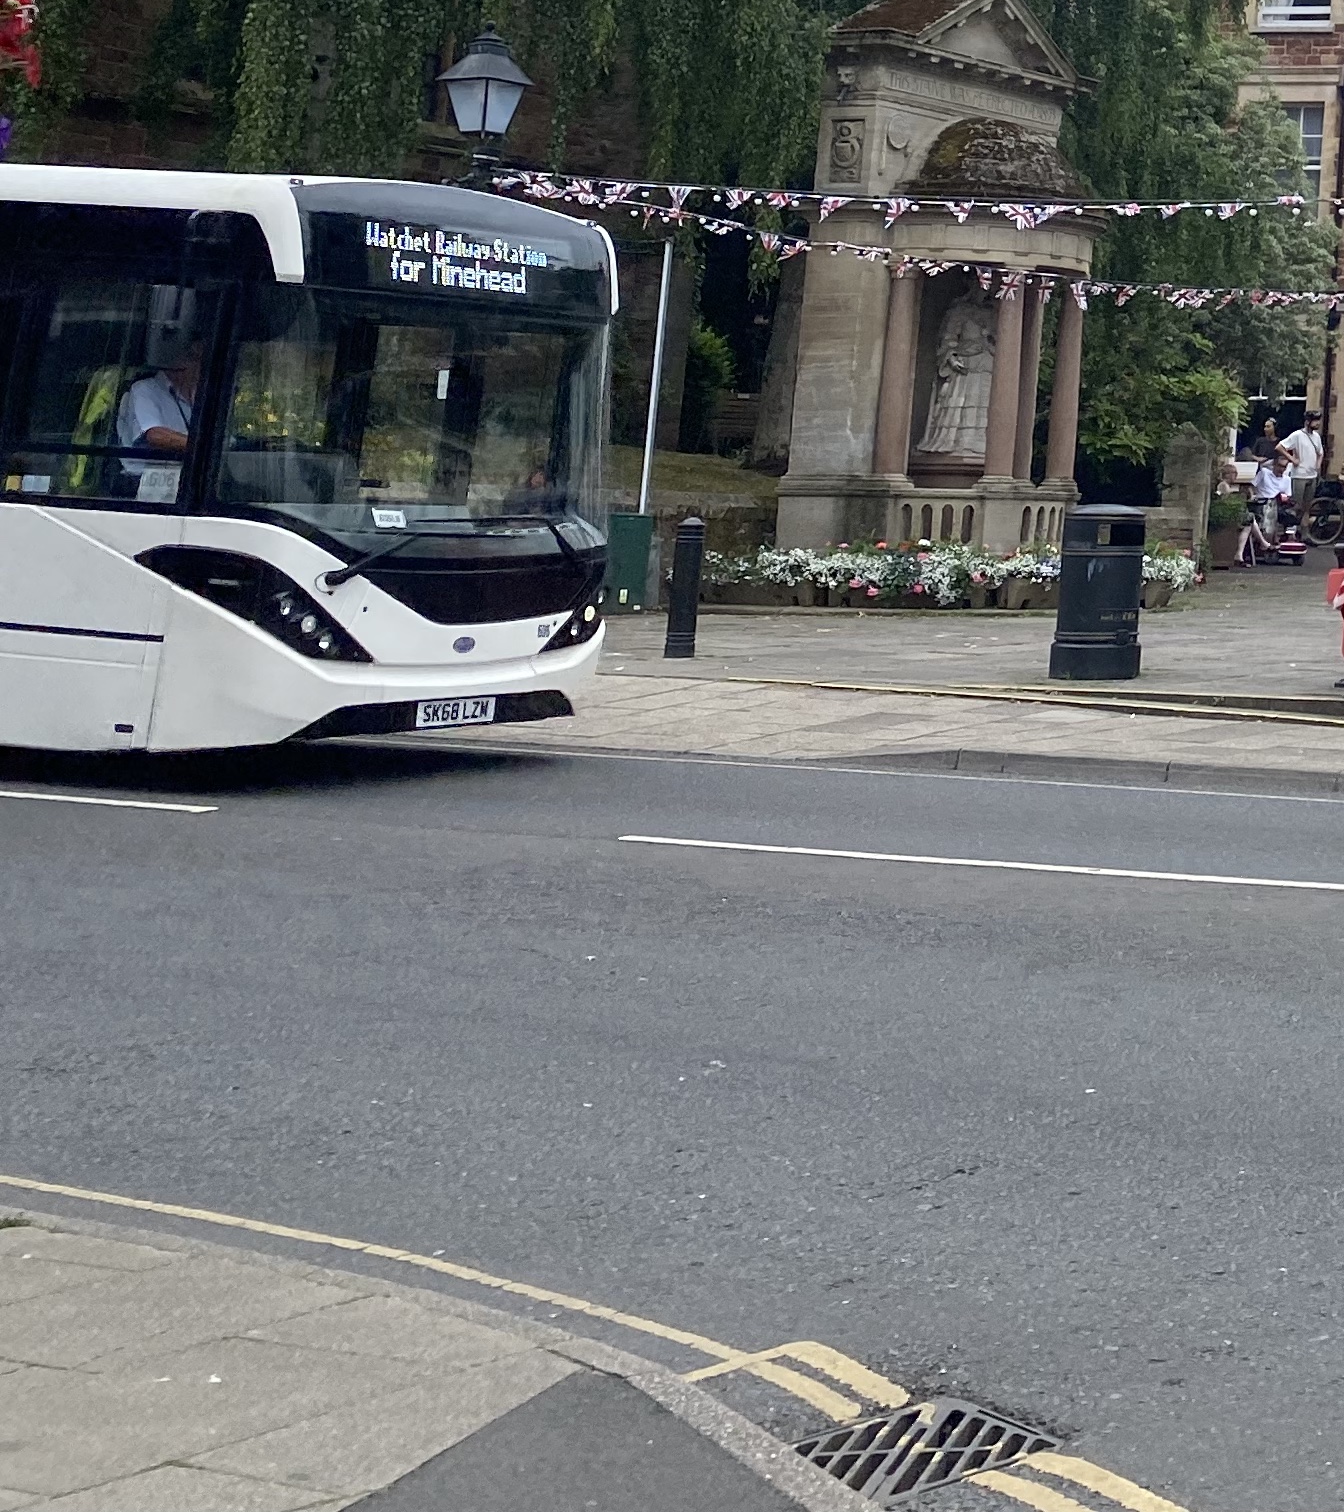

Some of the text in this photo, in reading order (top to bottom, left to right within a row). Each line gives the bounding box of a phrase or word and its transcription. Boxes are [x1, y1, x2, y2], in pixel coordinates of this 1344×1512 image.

[435, 230, 491, 260] Railway
[493, 238, 548, 268] Station
[390, 250, 528, 294] for Minehead
[423, 702, 460, 724] SK68
